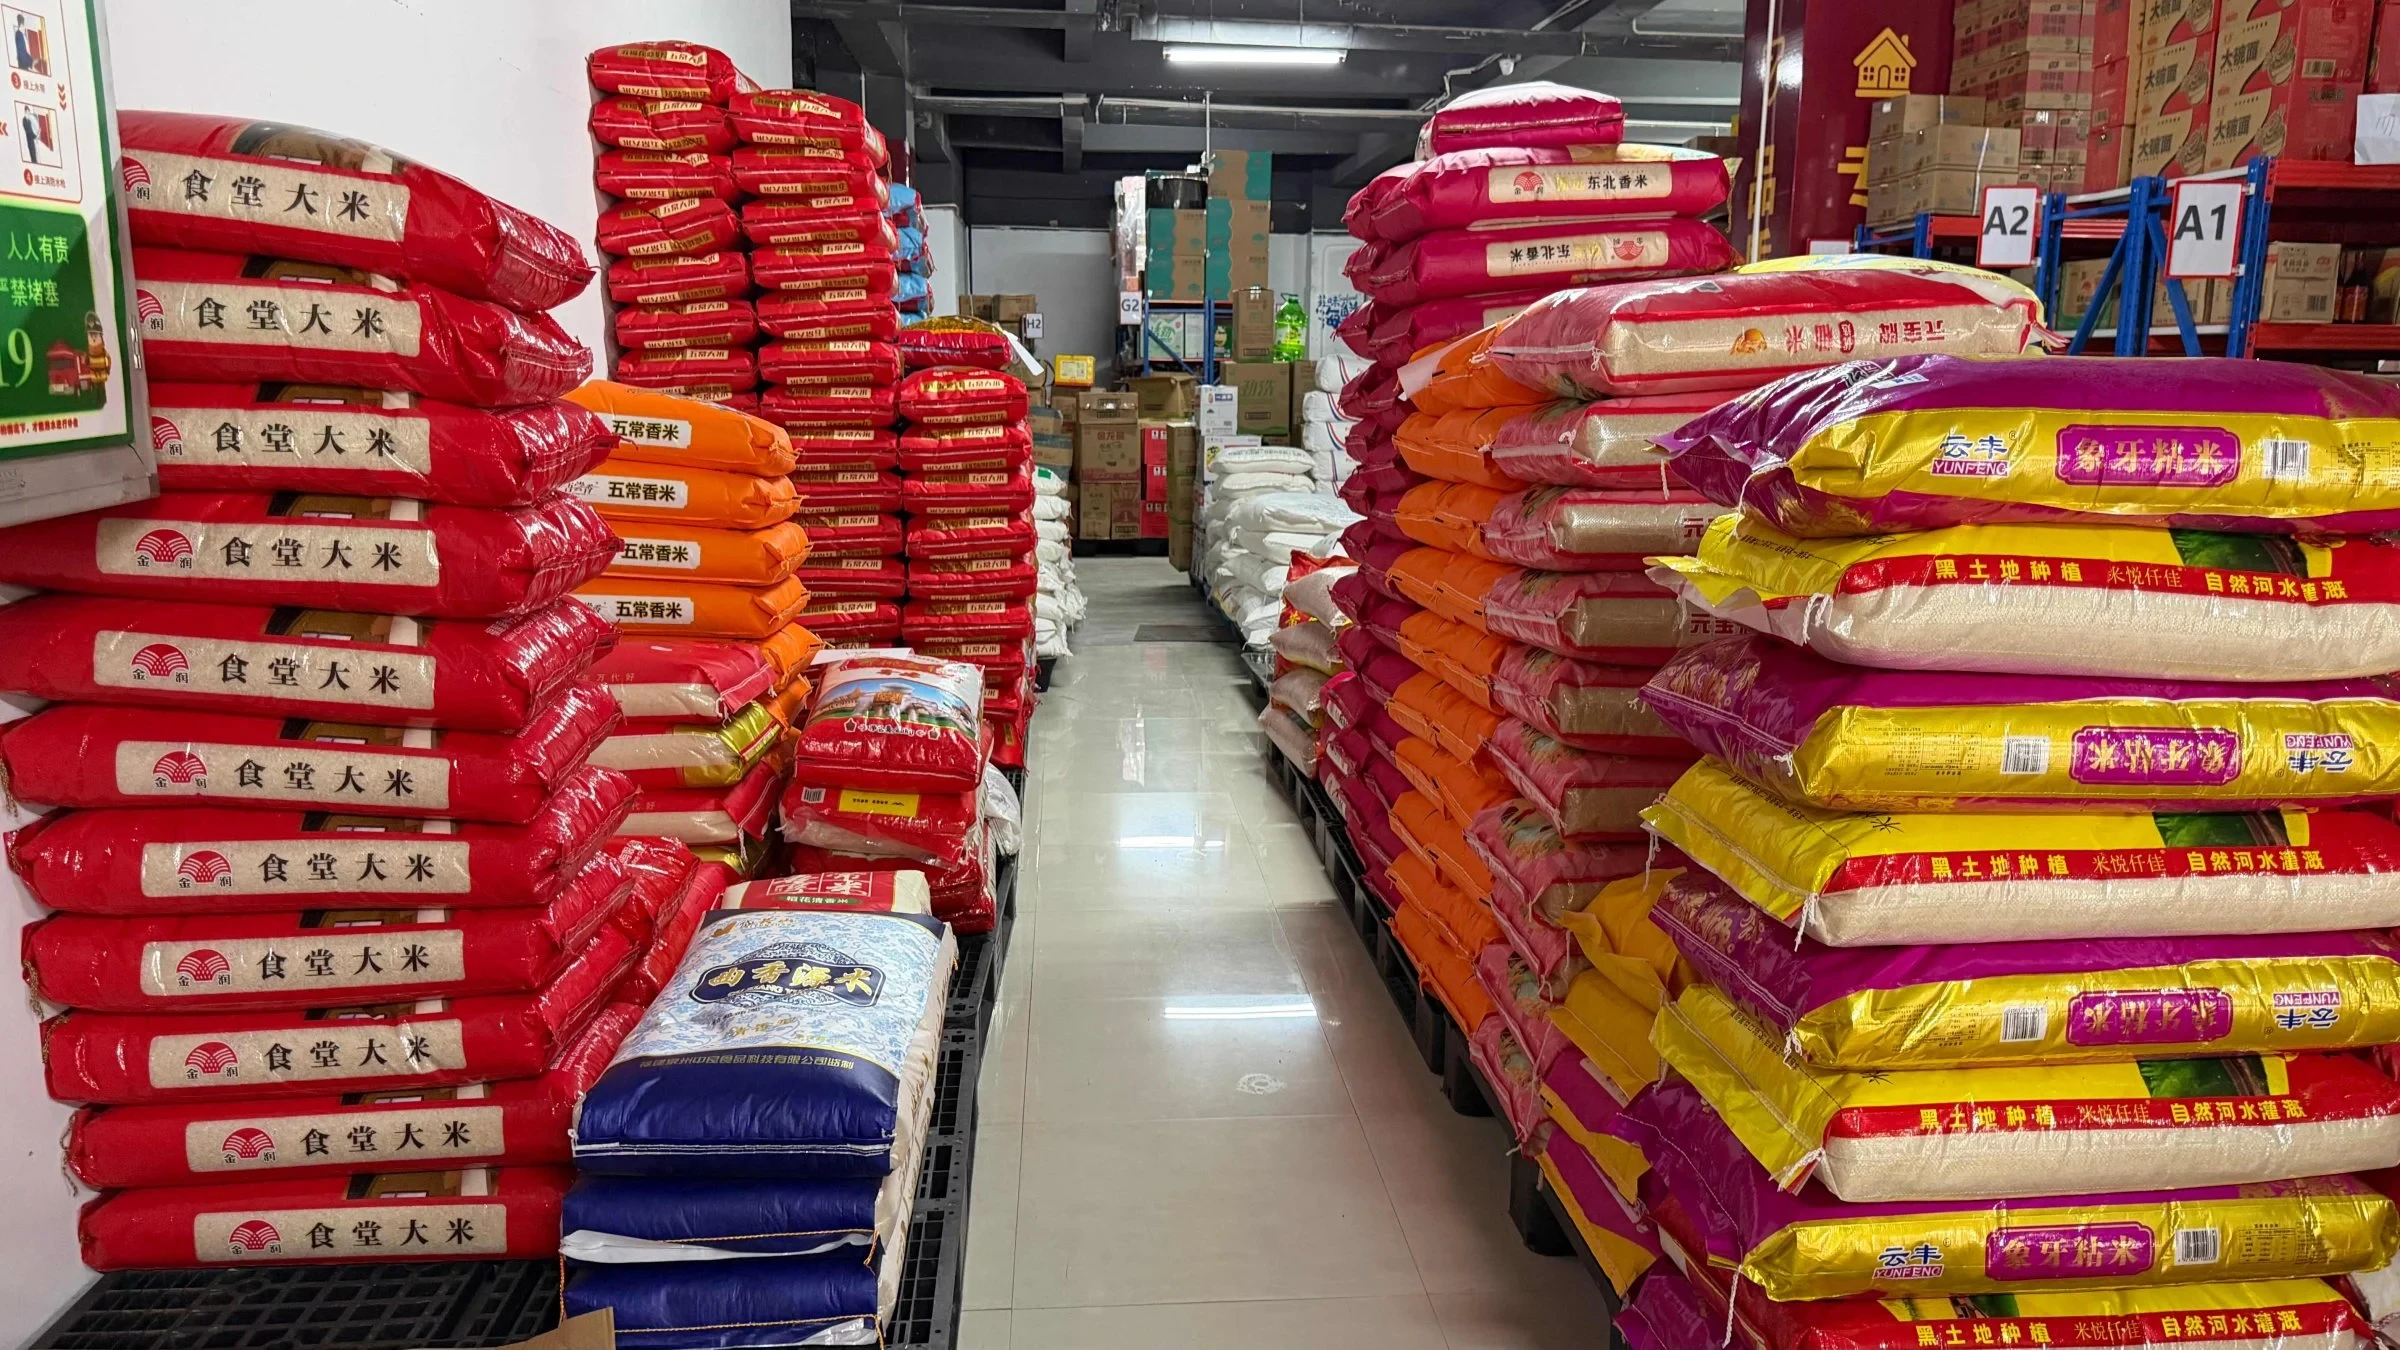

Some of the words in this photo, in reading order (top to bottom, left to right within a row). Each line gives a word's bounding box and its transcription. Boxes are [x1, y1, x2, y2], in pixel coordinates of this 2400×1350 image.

[182, 170, 371, 222] 食堂大米
[1588, 174, 1648, 191] 东北香米
[1983, 206, 2029, 236] A2
[2174, 204, 2226, 241] A1
[8, 231, 69, 263] 人人有责
[1510, 243, 1571, 261] 东北香米
[193, 297, 385, 338] 食堂大米
[1121, 299, 1139, 312] G2
[1027, 319, 1041, 328] H2
[211, 421, 397, 458] 食堂大米
[611, 420, 679, 441] 五常香米
[1939, 433, 2008, 456] 云丰
[1932, 461, 2008, 477] YUNFENG
[607, 481, 676, 502] 五常香米
[220, 536, 403, 571] 食堂大米
[620, 543, 689, 563] 五常香米
[1935, 558, 2084, 583] 黑土地种植
[2106, 564, 2182, 589] 米悦仟佳
[2204, 571, 2349, 603] 自然河水灌溉
[615, 600, 683, 619] 五常香米
[1690, 613, 1748, 635] 元宝
[217, 653, 400, 695] 食堂大米
[2285, 734, 2352, 749] YUNFENG
[2287, 751, 2354, 773] 云丰
[234, 759, 415, 796] 食堂大米
[258, 851, 437, 883] 食堂大米
[1930, 853, 2069, 879] 黑土地种植
[2092, 853, 2166, 875] 米悦仟佳
[2186, 848, 2327, 874] 自然河水灌溉
[257, 944, 430, 979] 食堂大米
[2274, 993, 2339, 1007] YUNFENG
[2276, 1008, 2340, 1031] 云丰
[265, 1038, 431, 1072] 食堂大米
[1918, 1105, 2055, 1130] 黑土地种植
[2080, 1102, 2151, 1125] 米悦仟佳
[2171, 1099, 2307, 1124] 自然河水灌溉
[300, 1120, 472, 1156] 食堂大米
[305, 1217, 475, 1249] 食堂大米
[1876, 1244, 1945, 1264] 云丰
[1874, 1265, 1943, 1280] YUNFENG
[1915, 1324, 2052, 1347] 黑土地种植
[2073, 1319, 2143, 1341] 米悦仟佳
[2161, 1310, 2304, 1338] 自然河水灌溉
